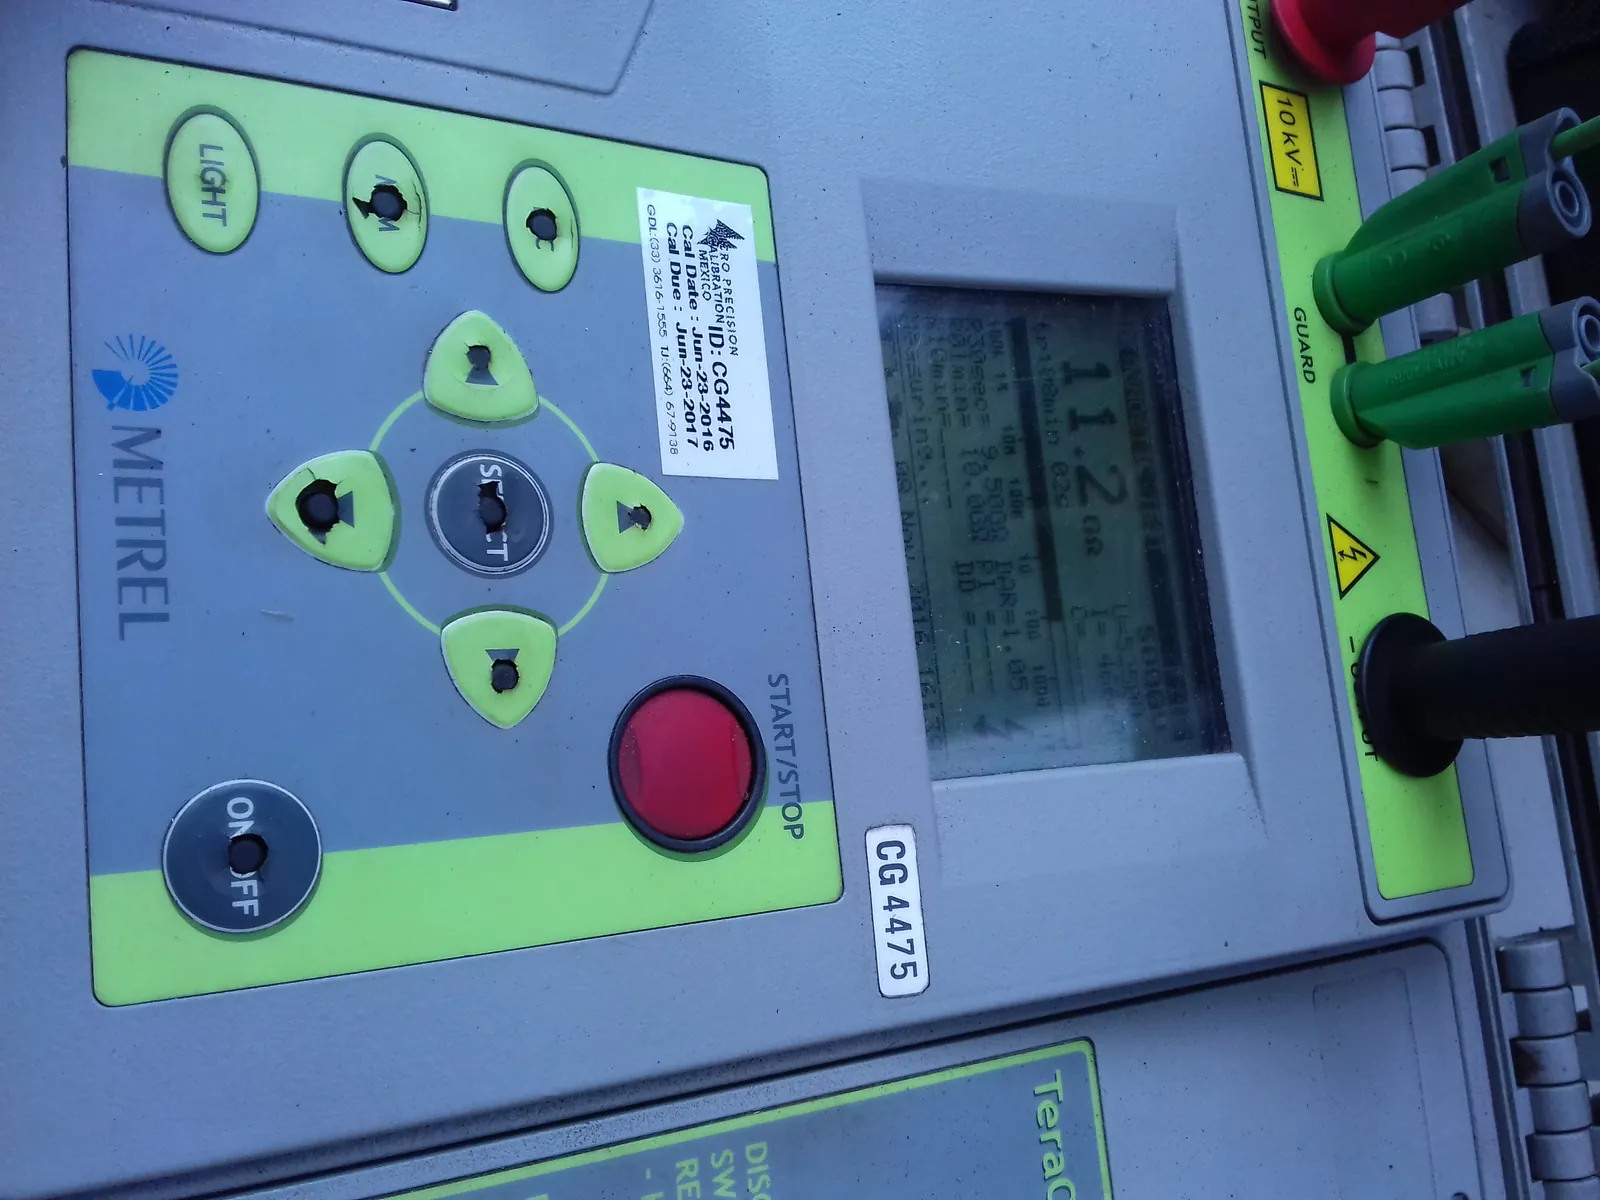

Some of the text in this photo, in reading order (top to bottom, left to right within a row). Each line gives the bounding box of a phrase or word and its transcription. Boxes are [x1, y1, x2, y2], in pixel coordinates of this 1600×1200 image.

[1247, 0, 1266, 60] TPUT
[1276, 97, 1302, 166] 10 kV
[199, 143, 227, 227] LIGHT
[666, 222, 679, 254] Cal
[682, 225, 694, 258] Cal
[698, 249, 712, 301] MEXICO
[668, 261, 683, 300] Due
[684, 264, 699, 310] Date
[722, 279, 739, 356] PRECISION
[653, 267, 668, 338] 3616-1555
[665, 401, 679, 455] 67-9138
[1293, 306, 1316, 384] GUARD
[675, 321, 699, 448] Jun-23-2017
[691, 326, 714, 451] Jun-23-2016
[707, 325, 735, 450] ID: CG4475
[1062, 361, 1128, 507] 11.2
[111, 424, 170, 641] METREL
[767, 674, 804, 840] START/STOP
[876, 840, 918, 980] CG 4475
[745, 1141, 771, 1200] DIS
